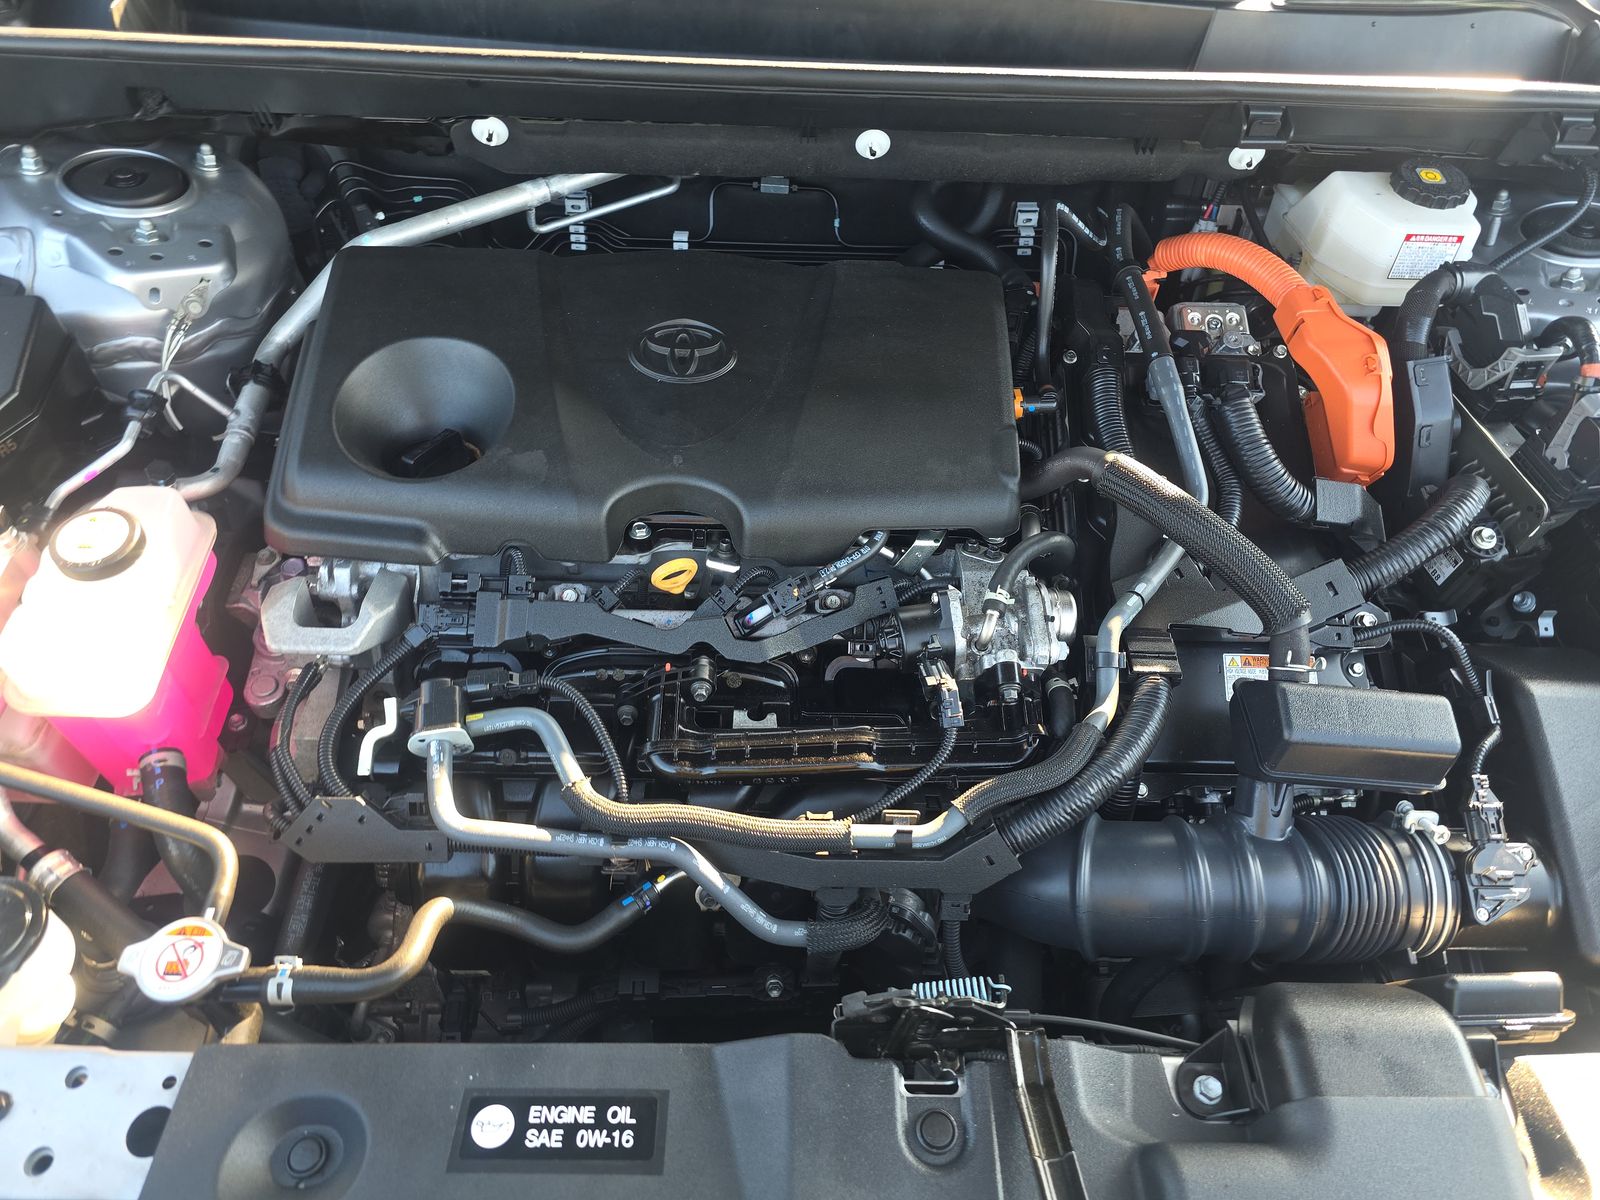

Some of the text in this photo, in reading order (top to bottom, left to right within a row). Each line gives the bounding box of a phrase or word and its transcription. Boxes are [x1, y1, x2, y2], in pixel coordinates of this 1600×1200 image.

[528, 1105, 637, 1124] ENGINE OIL
[524, 1128, 634, 1148] SAE 0W-16
